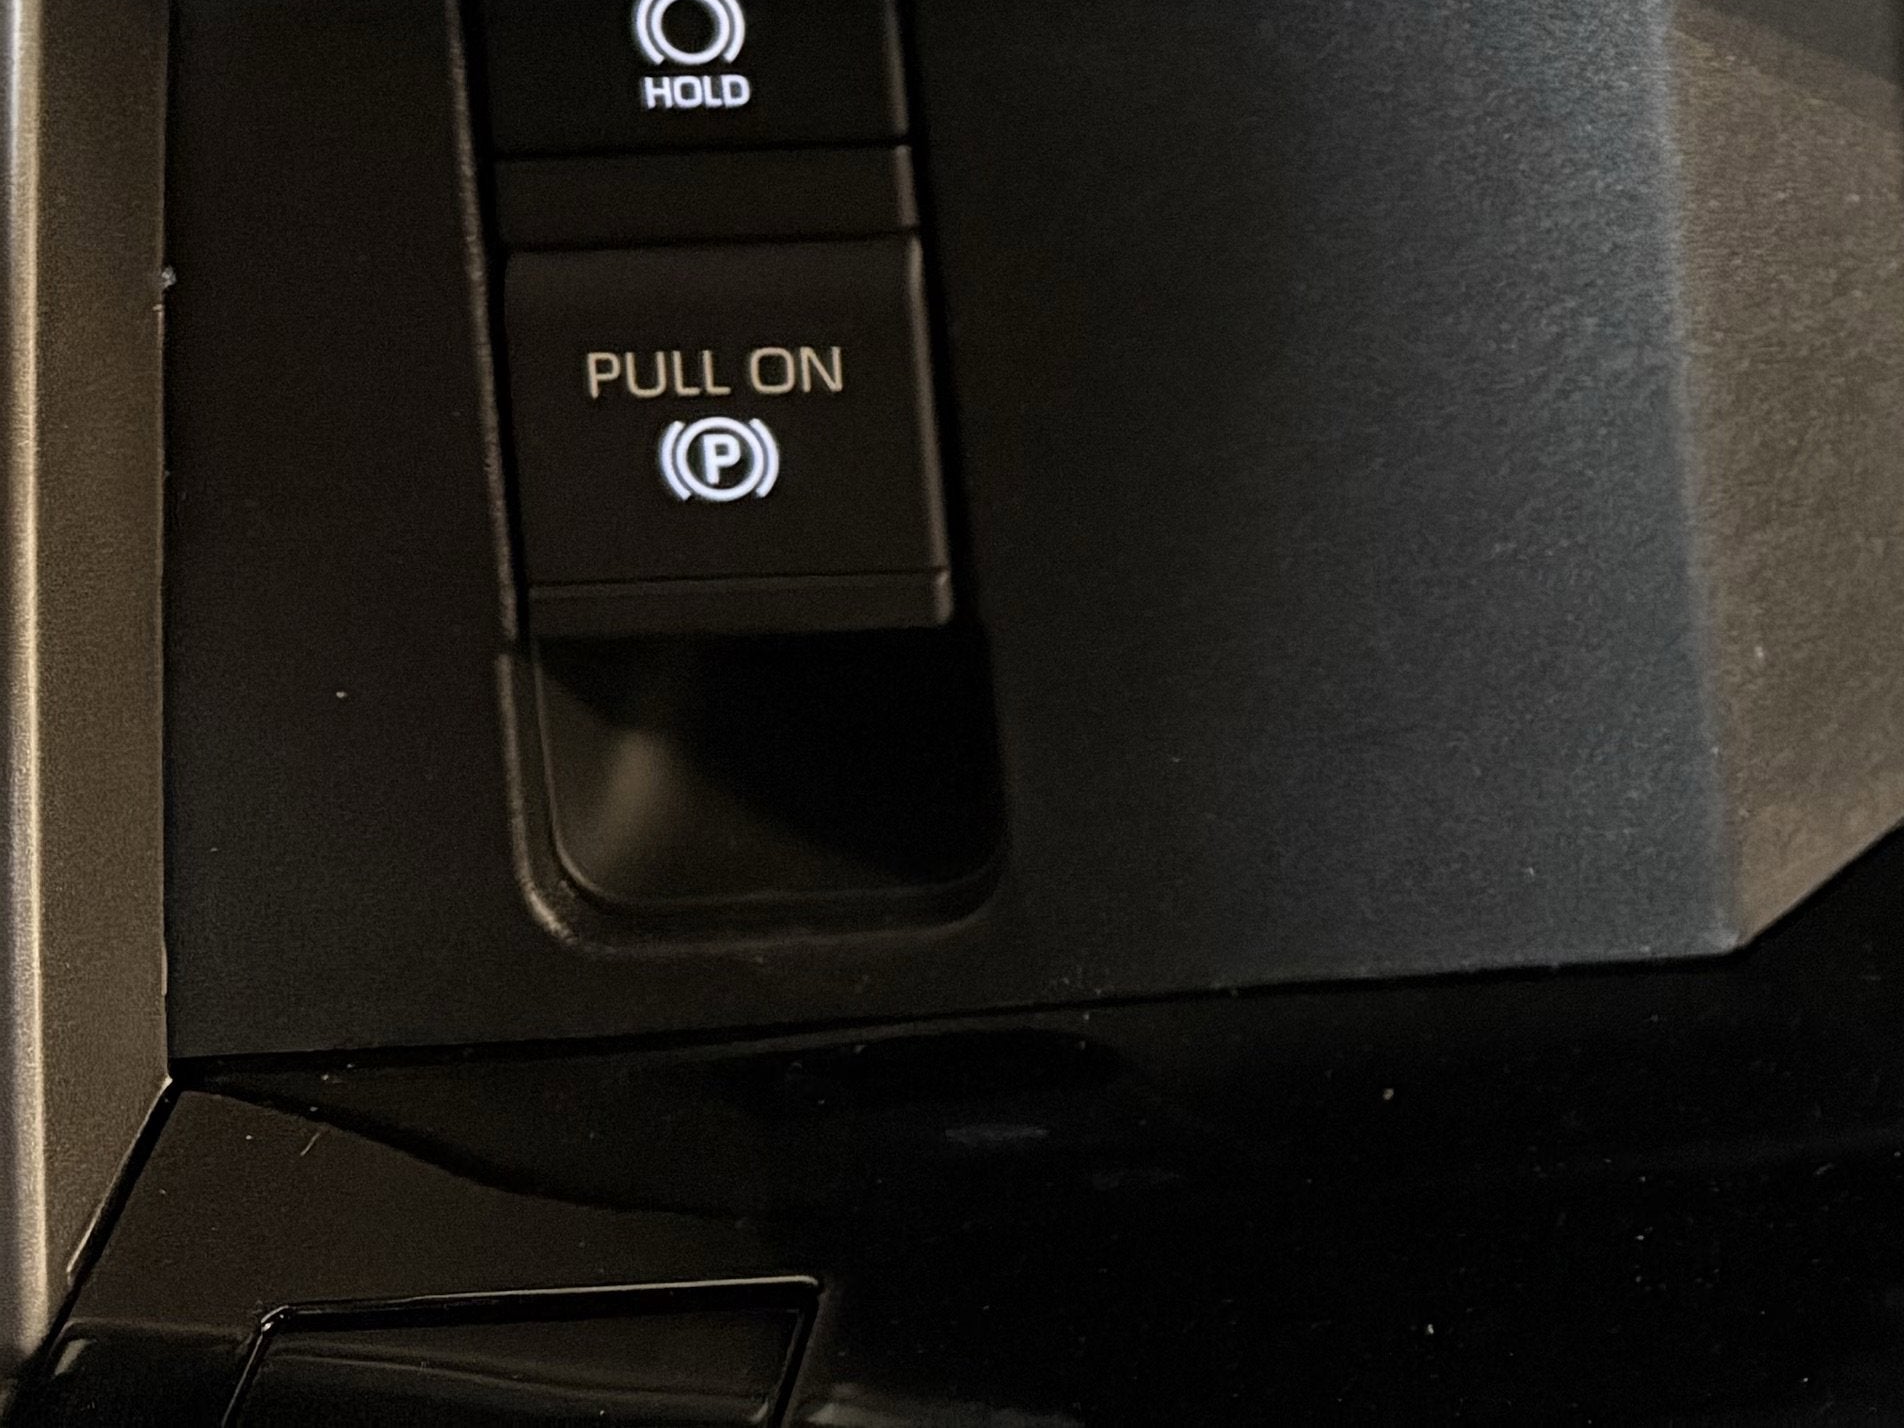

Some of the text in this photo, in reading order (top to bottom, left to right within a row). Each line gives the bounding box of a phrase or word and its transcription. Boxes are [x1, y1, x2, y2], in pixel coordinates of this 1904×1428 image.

[643, 74, 750, 108] HOLD
[587, 346, 843, 398] PULL ON
